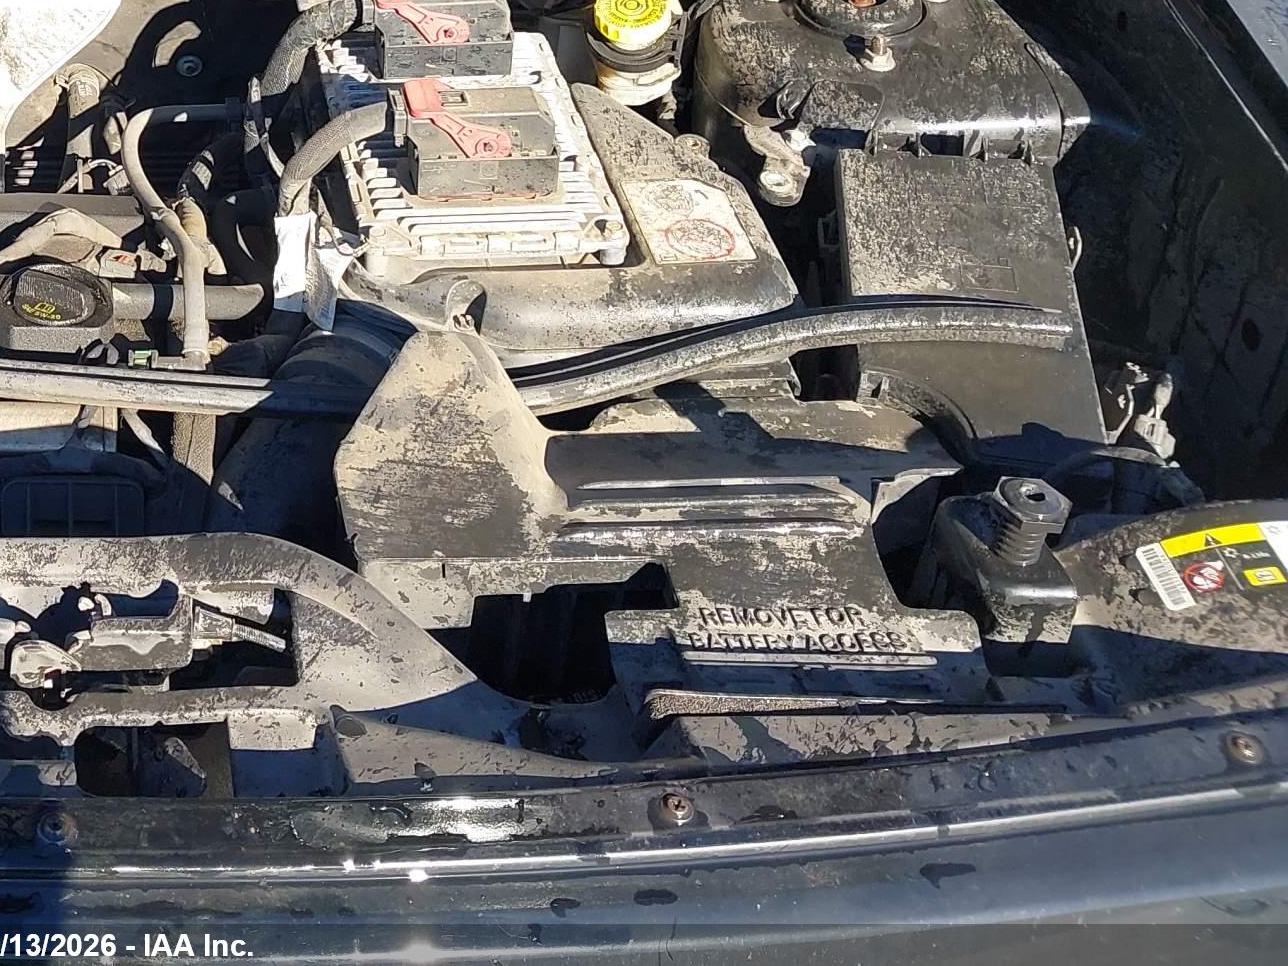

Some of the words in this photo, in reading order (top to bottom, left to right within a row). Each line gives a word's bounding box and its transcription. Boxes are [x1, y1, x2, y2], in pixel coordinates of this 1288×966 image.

[699, 607, 807, 628] REMOVE
[811, 607, 865, 628] FOR
[688, 632, 803, 651] BATTERY
[809, 632, 907, 653] ACCESS
